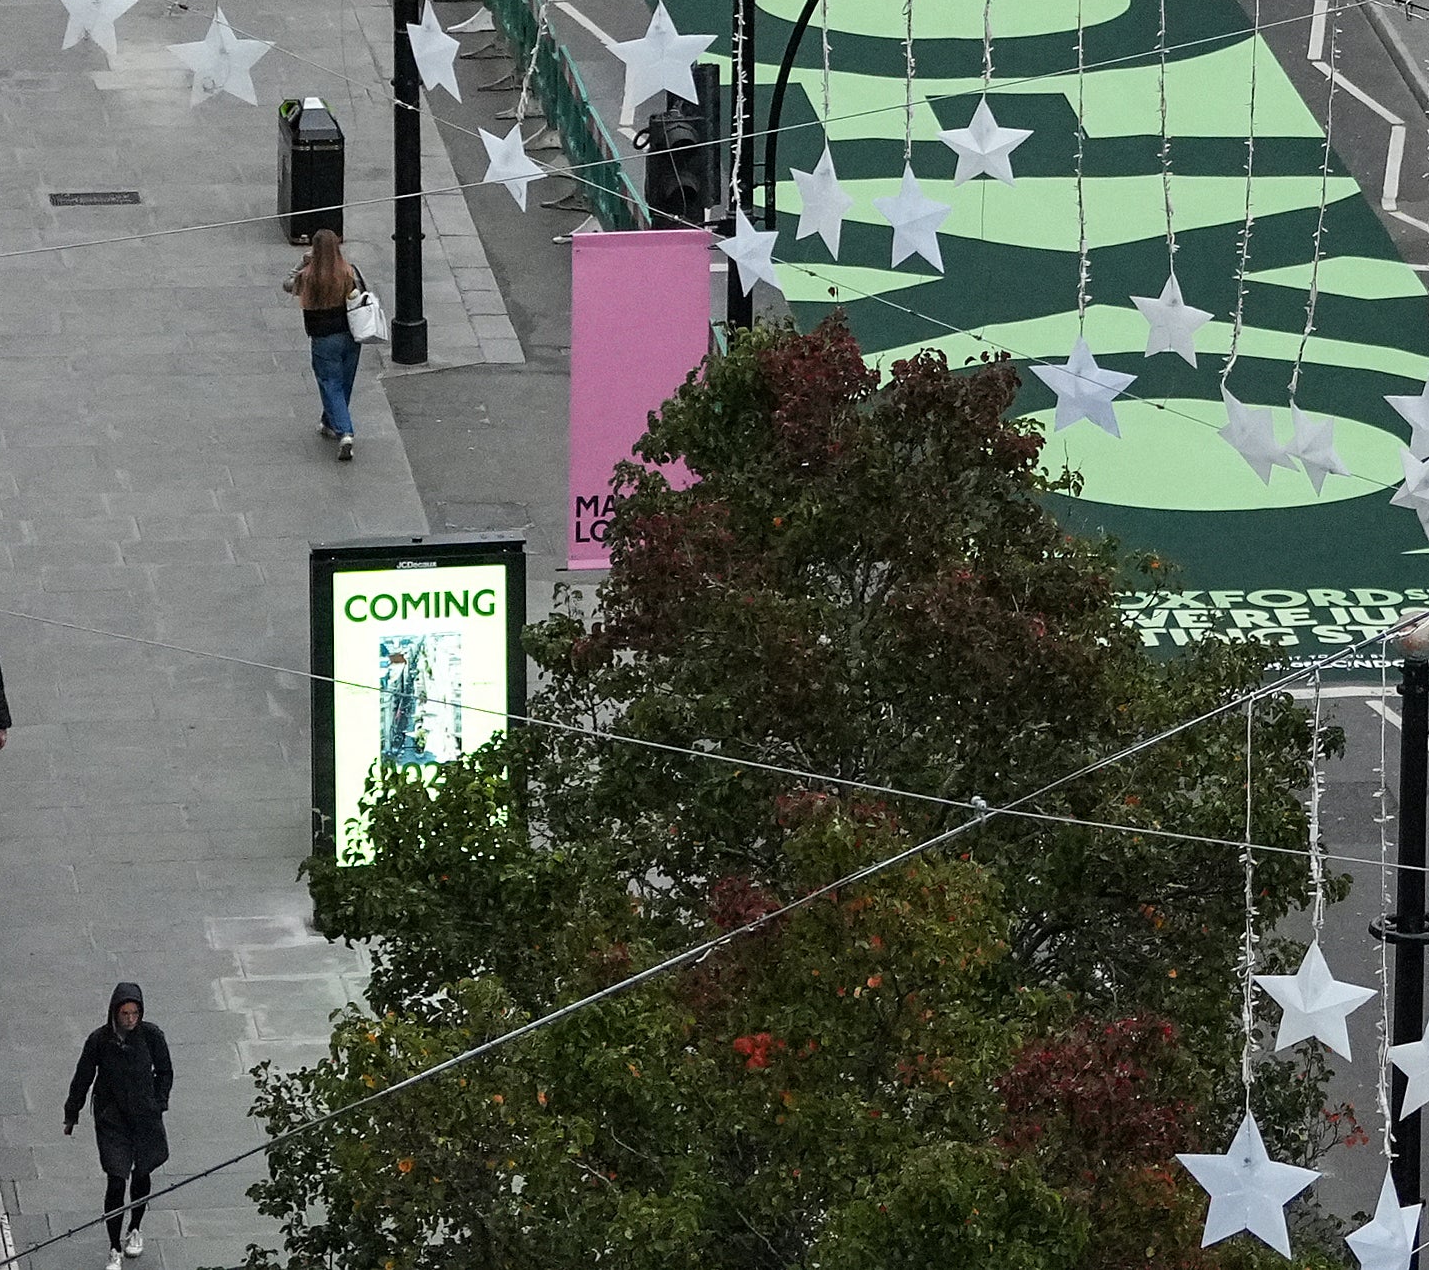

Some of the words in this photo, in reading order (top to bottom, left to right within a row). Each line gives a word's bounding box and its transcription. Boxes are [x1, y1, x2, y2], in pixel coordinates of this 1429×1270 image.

[396, 560, 438, 570] JCDecaux
[344, 588, 496, 624] COMING
[1121, 608, 1312, 630] WE'RE
